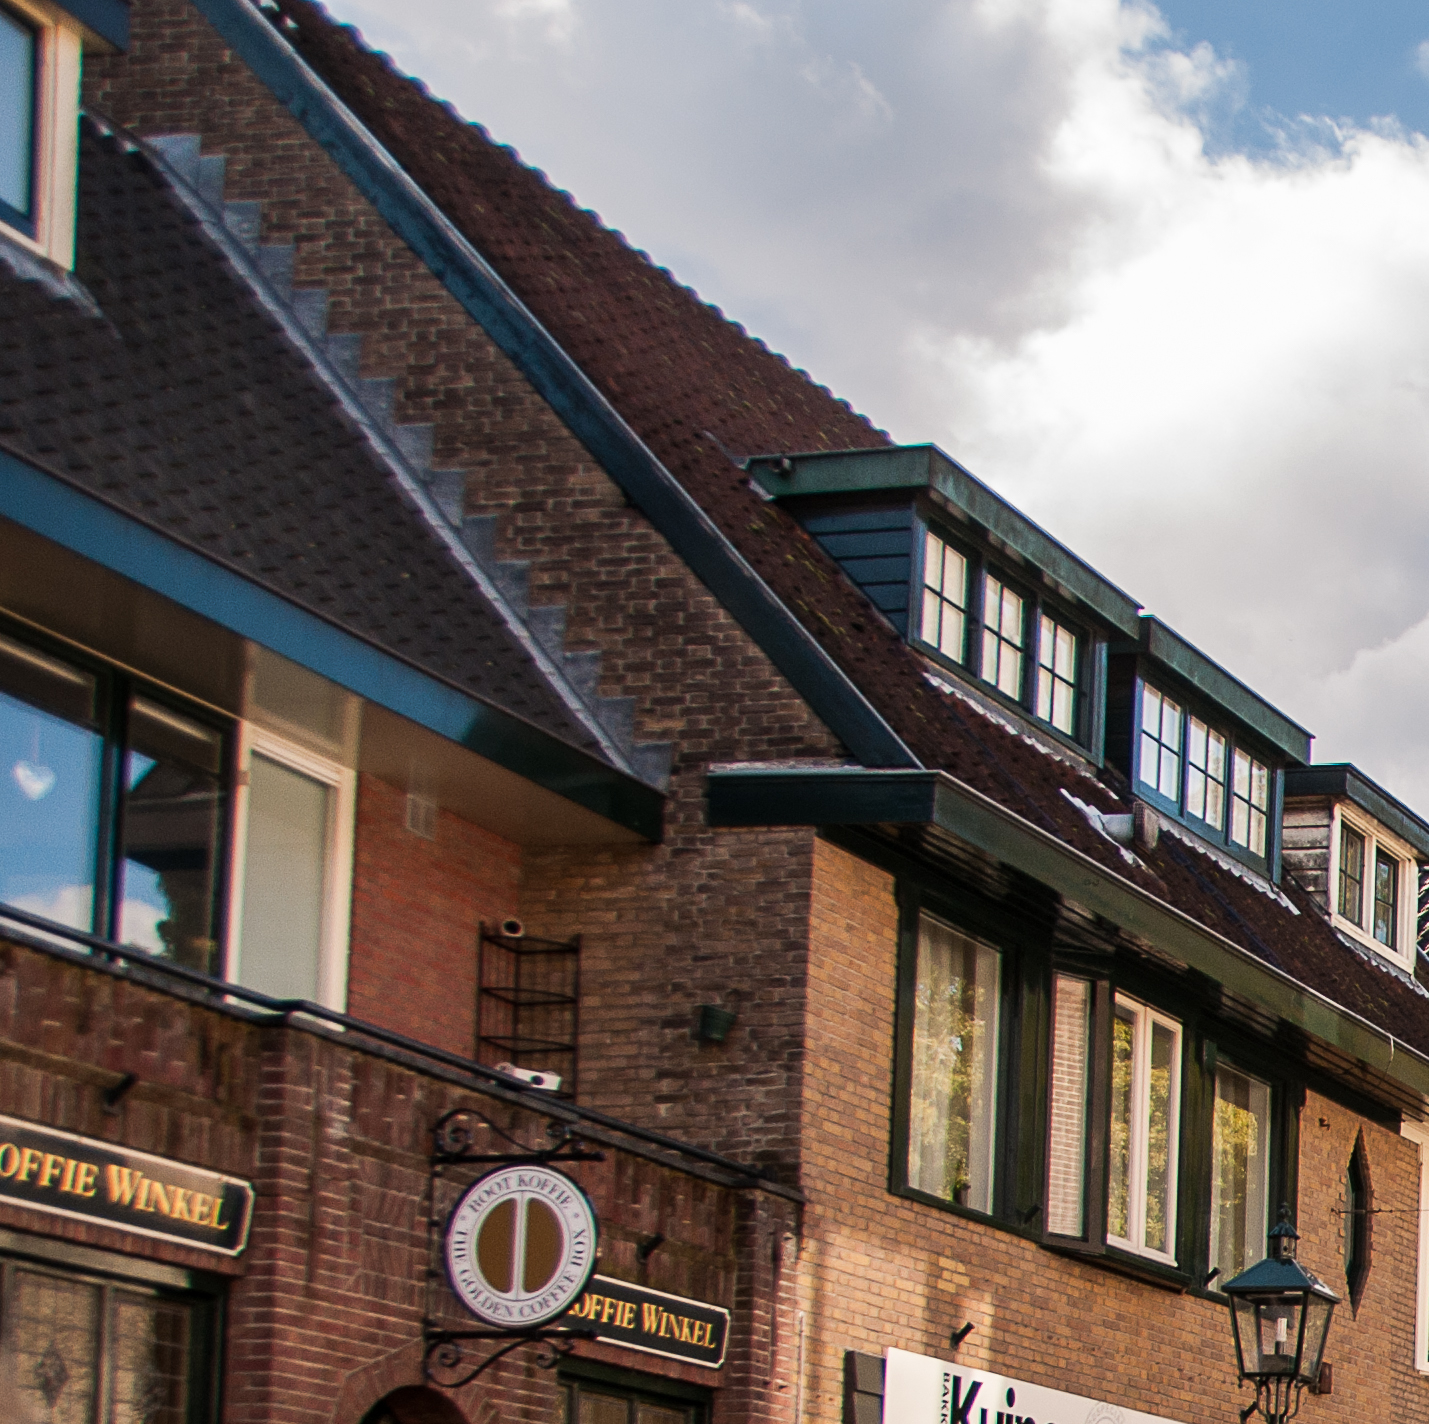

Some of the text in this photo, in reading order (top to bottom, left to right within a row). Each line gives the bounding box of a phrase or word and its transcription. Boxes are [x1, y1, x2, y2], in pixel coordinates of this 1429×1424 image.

[517, 1174, 570, 1210] KOFFIE
[459, 1268, 514, 1319] GOLDEN
[518, 1273, 577, 1320] COFFEE
[570, 1228, 587, 1268] BOX
